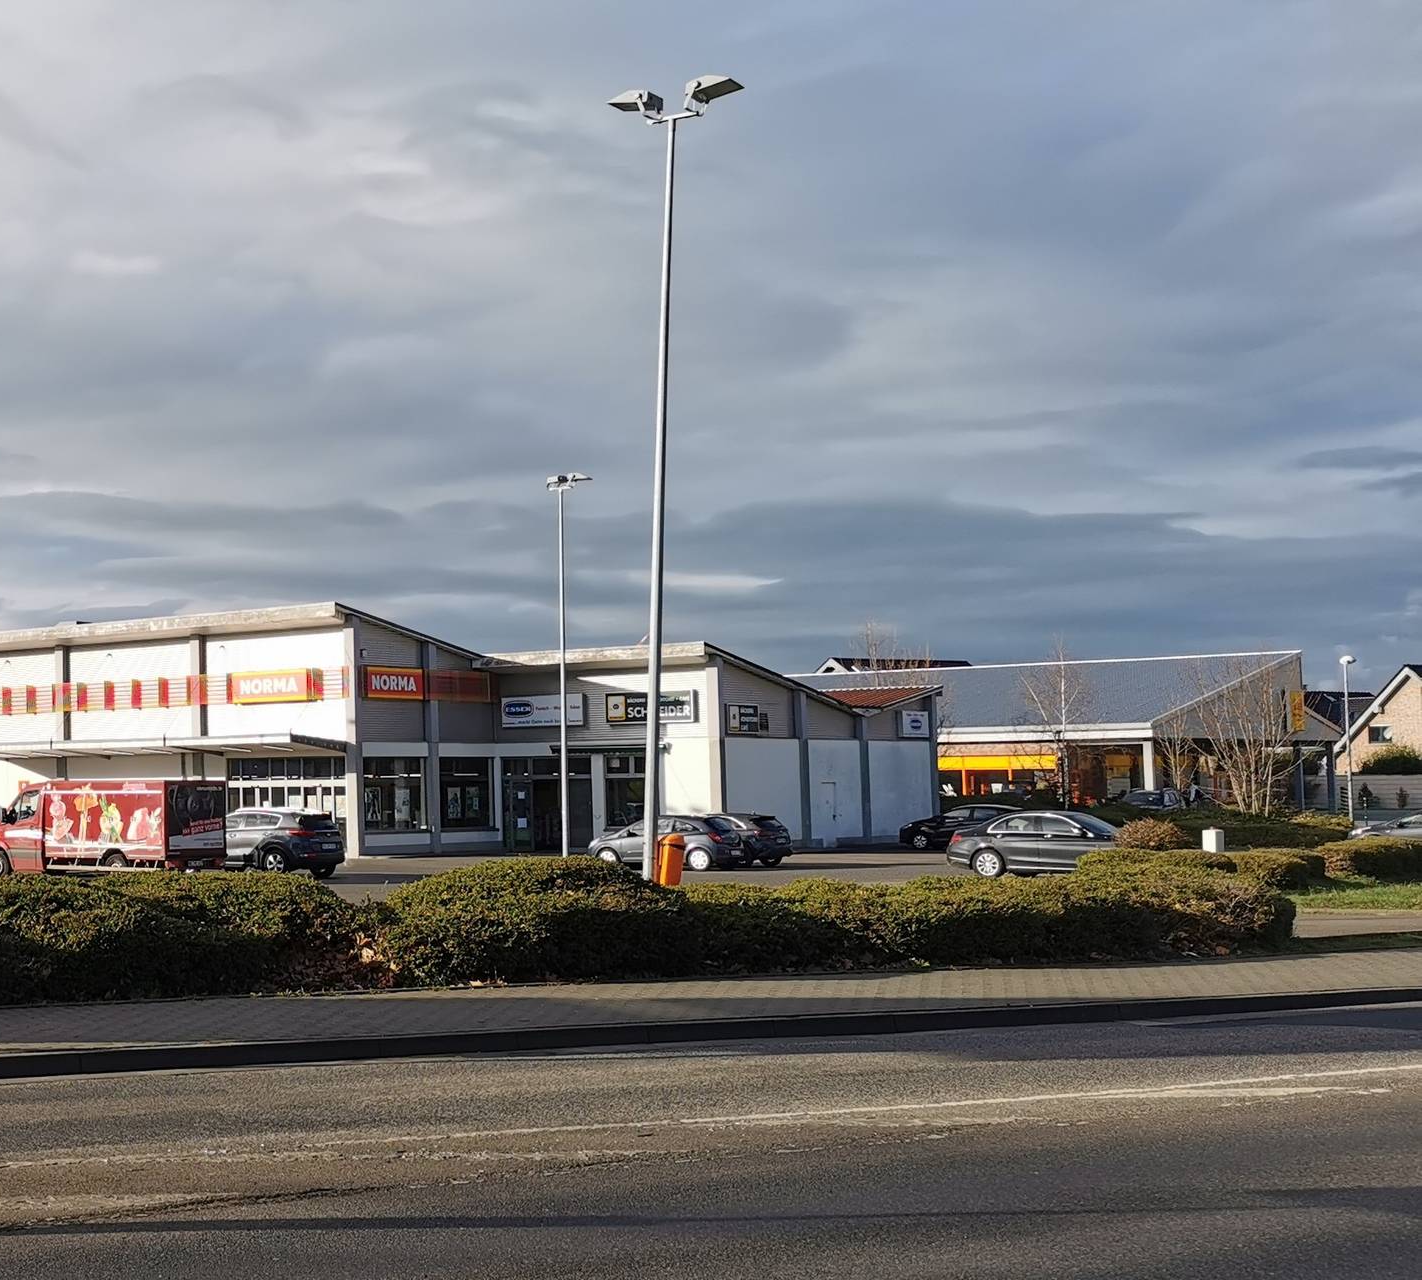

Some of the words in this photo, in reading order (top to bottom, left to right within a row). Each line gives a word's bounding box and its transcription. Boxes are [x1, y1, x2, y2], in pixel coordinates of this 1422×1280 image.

[240, 677, 298, 694] NORMA
[372, 675, 417, 692] NORMA
[627, 705, 691, 718] SCHEIDER
